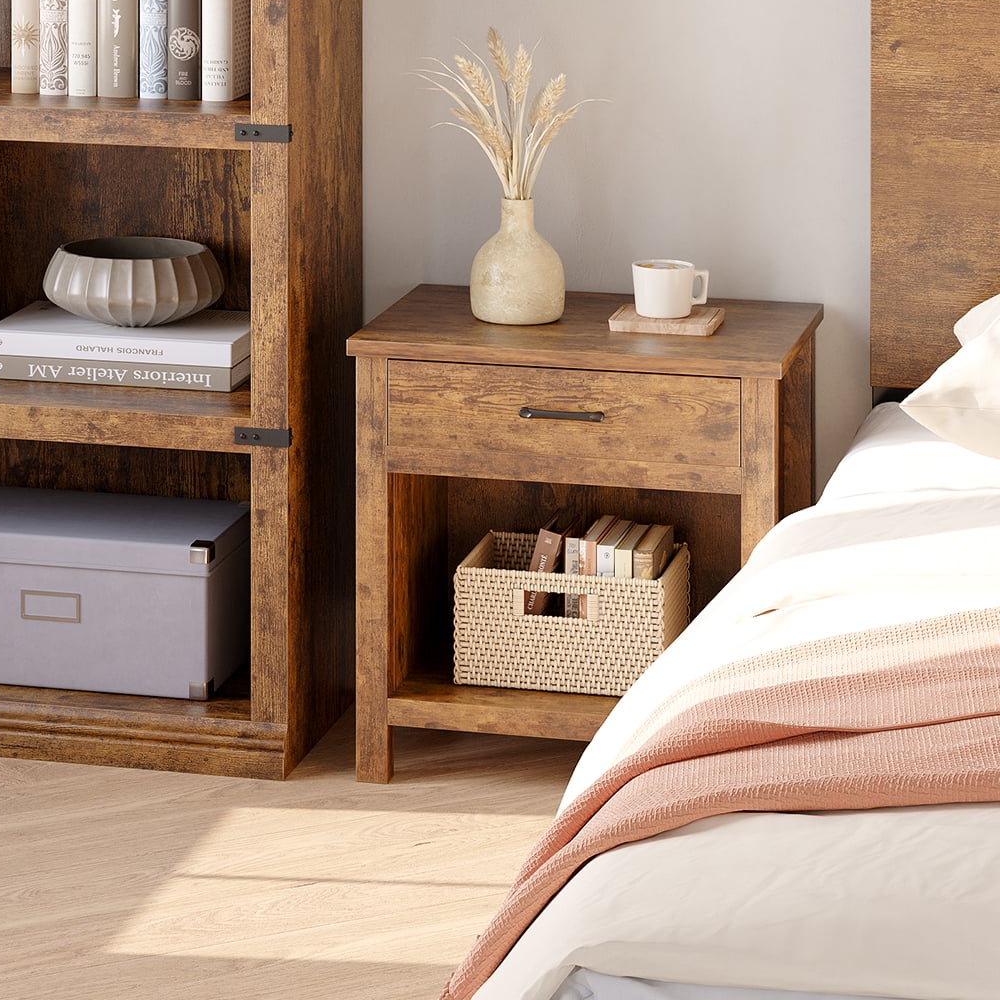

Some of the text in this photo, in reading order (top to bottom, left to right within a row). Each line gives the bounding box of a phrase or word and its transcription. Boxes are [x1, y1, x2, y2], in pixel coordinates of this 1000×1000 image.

[76, 344, 163, 356] FRANCOIS HALARD
[28, 363, 212, 388] Interiors Atelier AM
